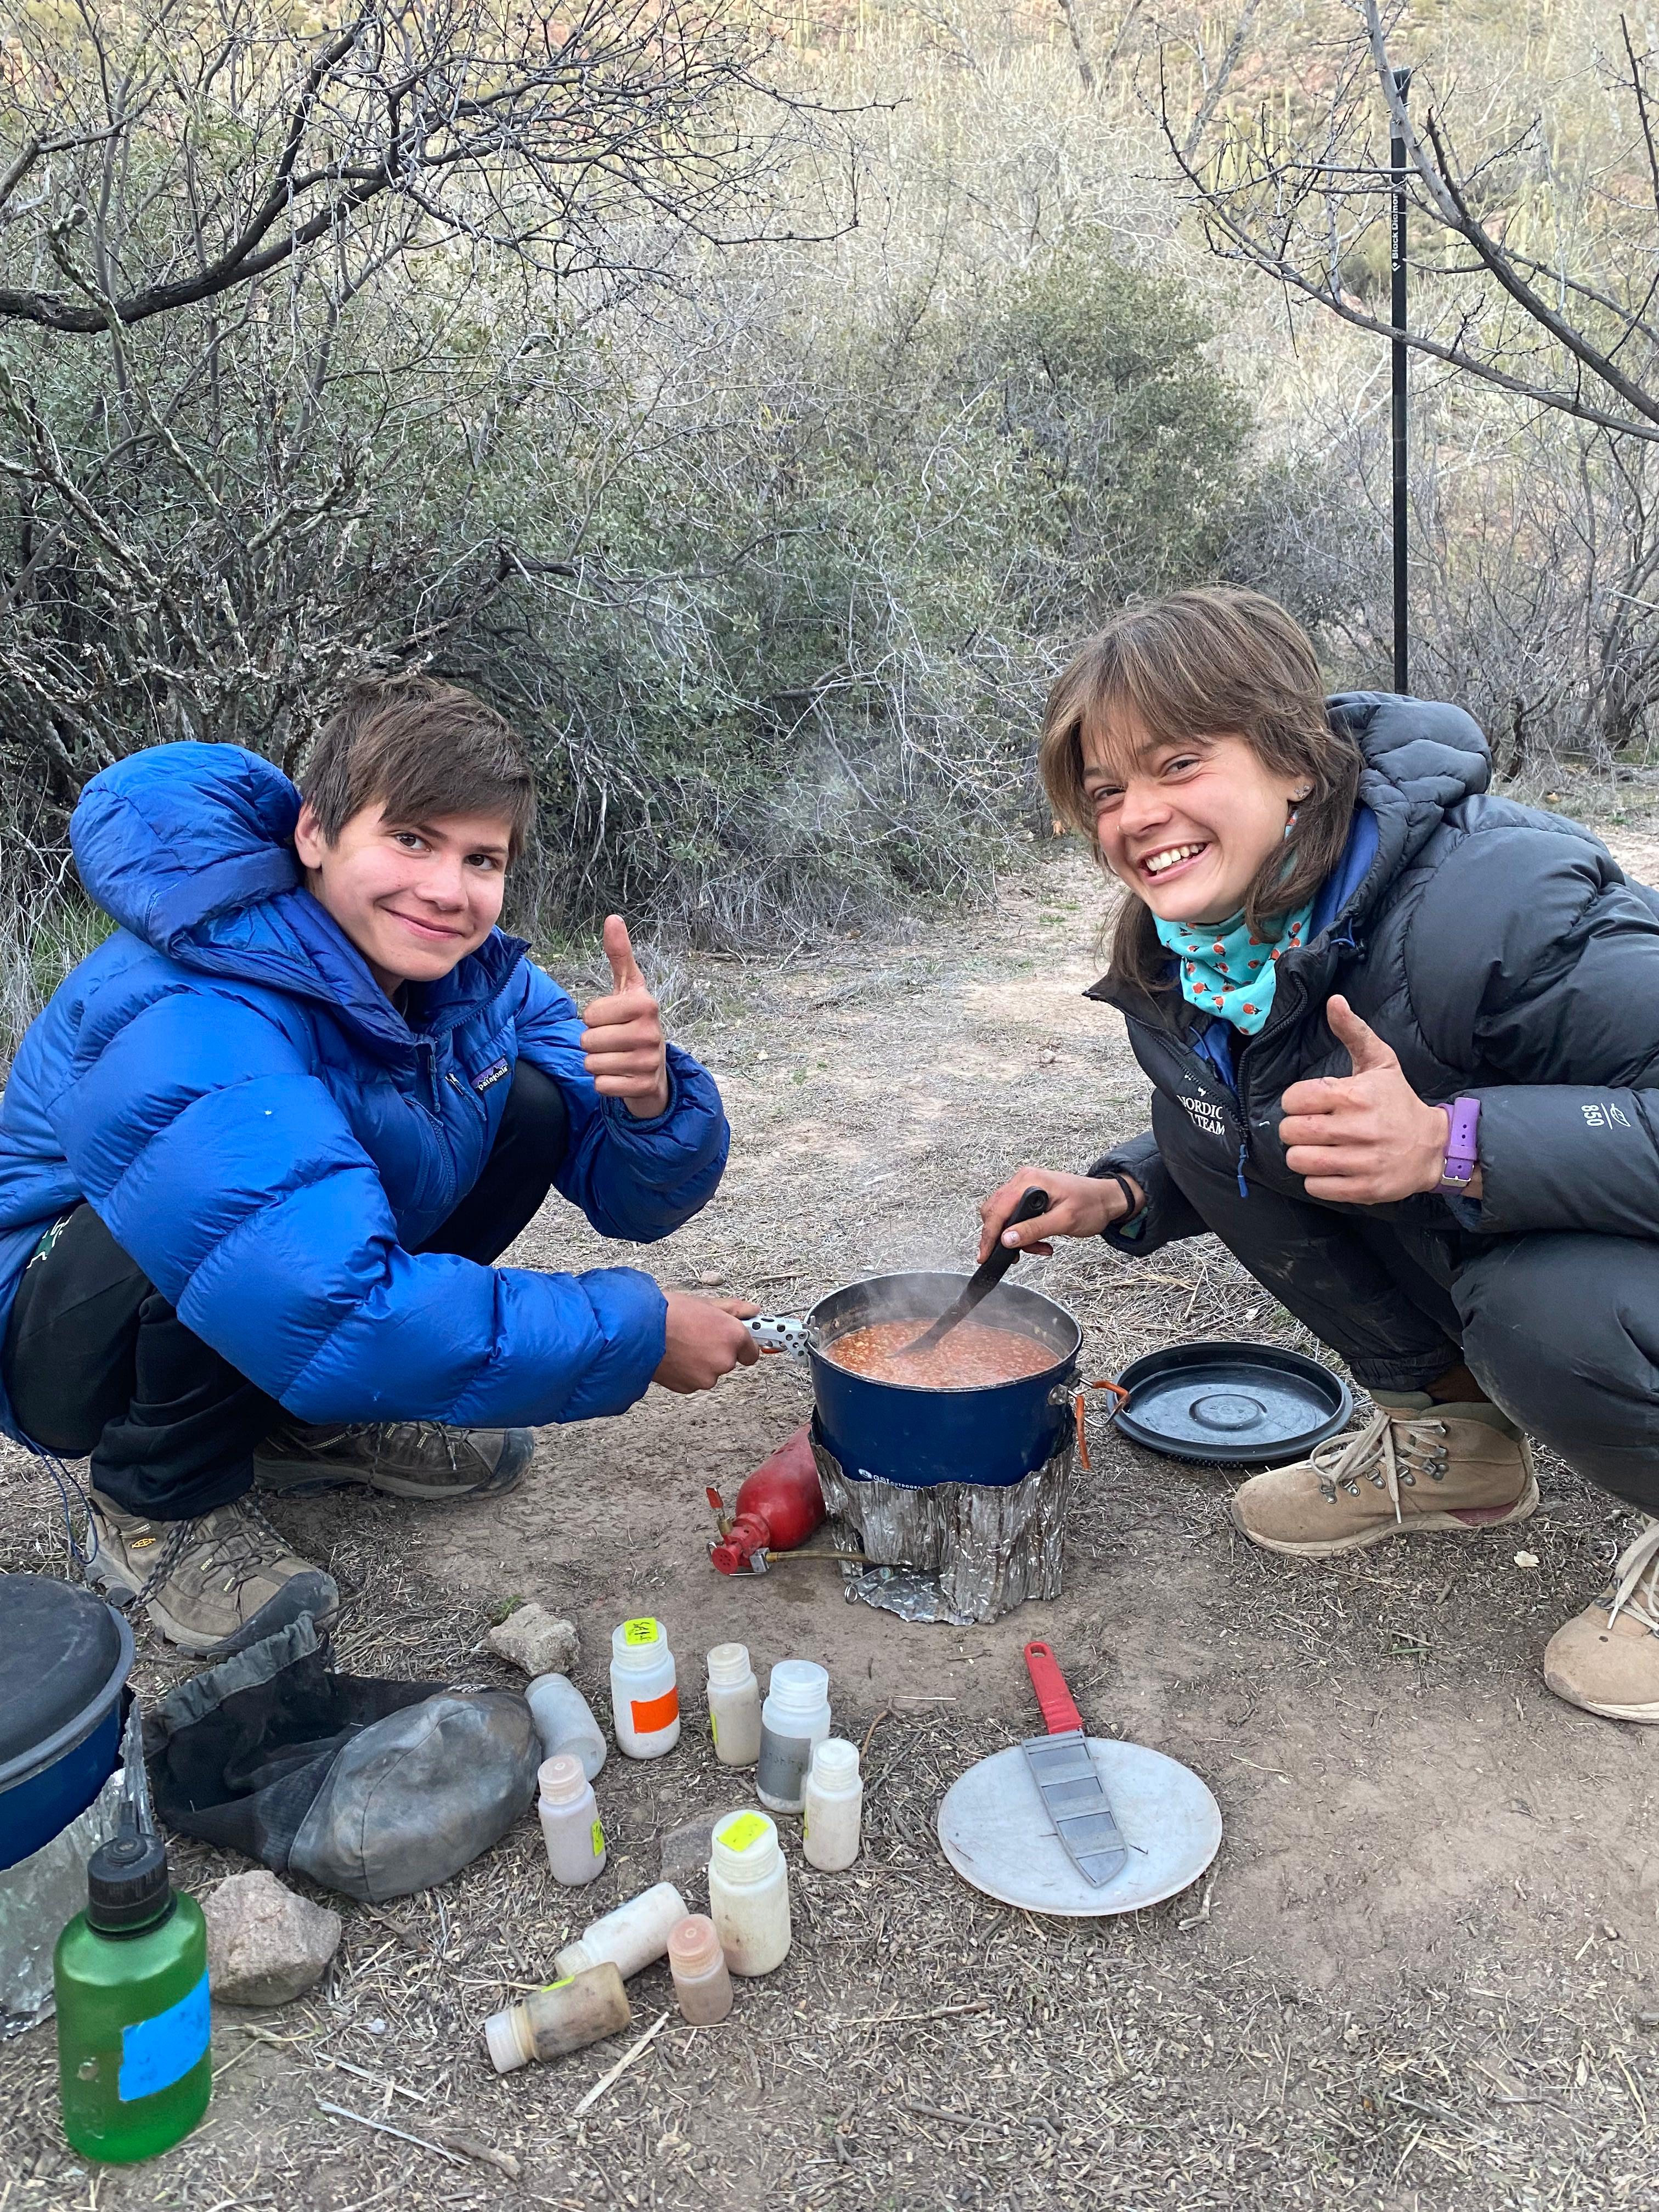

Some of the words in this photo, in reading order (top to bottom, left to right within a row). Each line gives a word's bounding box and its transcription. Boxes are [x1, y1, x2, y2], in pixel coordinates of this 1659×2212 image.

[478, 1065, 508, 1091] patagonia
[1176, 1094, 1223, 1120] NORDIC
[1581, 1104, 1605, 1127] 850
[1194, 1114, 1226, 1136] TEAM
[873, 1475, 890, 1484] GSI
[132, 1537, 156, 1549] KEEN
